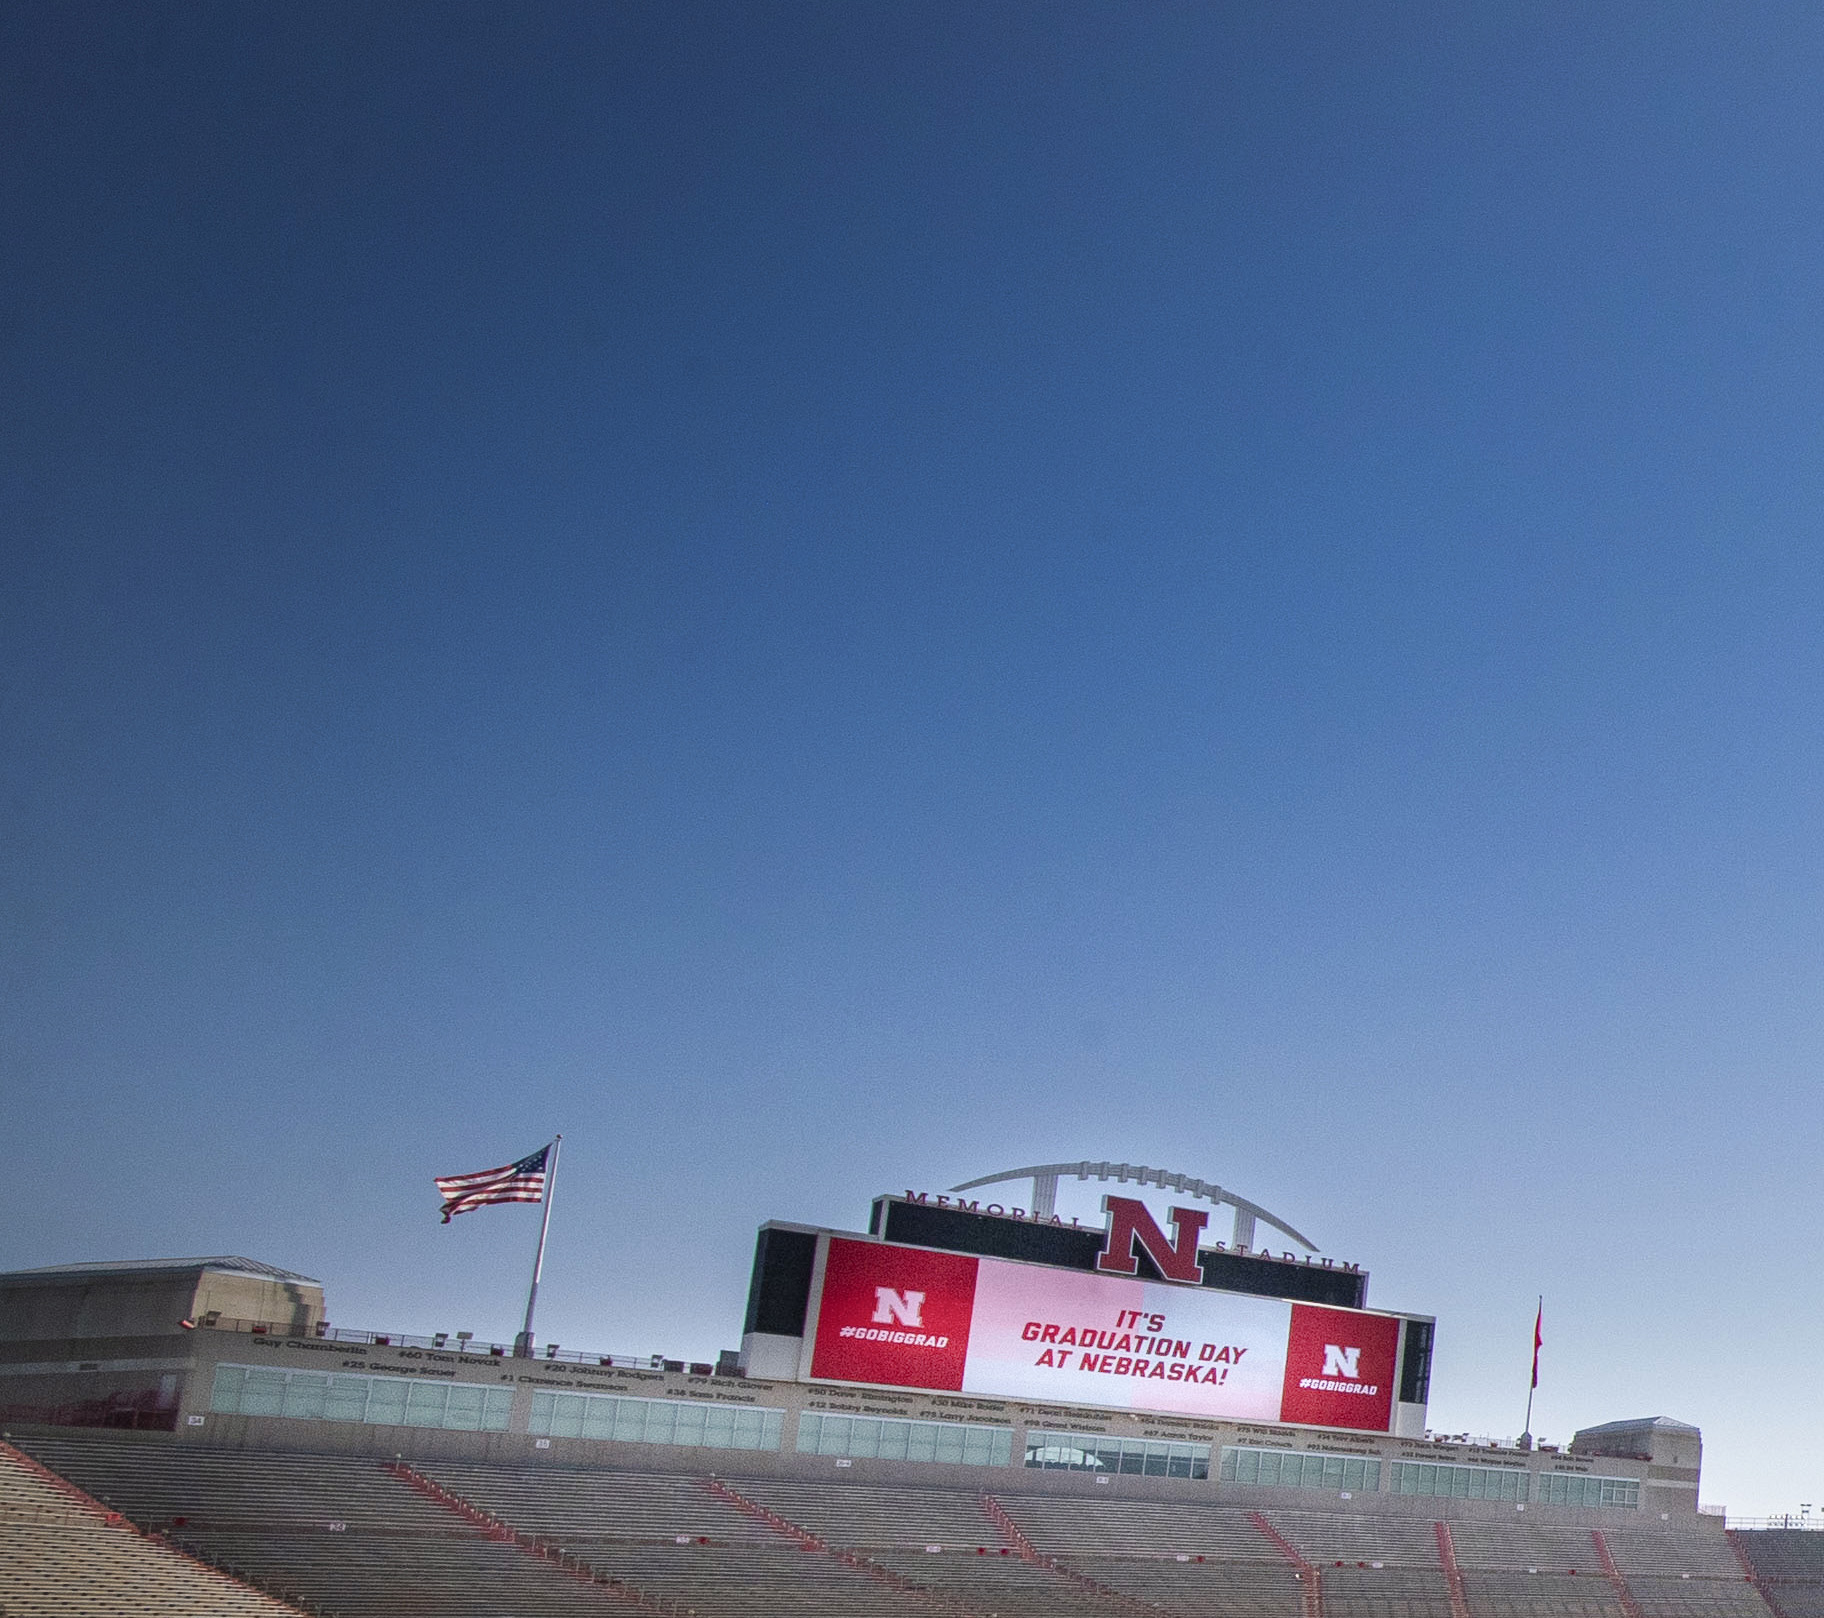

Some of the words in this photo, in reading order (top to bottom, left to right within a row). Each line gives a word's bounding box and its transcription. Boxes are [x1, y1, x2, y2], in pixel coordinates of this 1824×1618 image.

[905, 1190, 1080, 1229] MEMORIAL
[1096, 1193, 1210, 1284] N
[1216, 1241, 1361, 1272] STADIUM
[872, 1287, 925, 1327] N
[1116, 1309, 1165, 1333] IT'S
[253, 1338, 282, 1348] Guy
[838, 1326, 949, 1350] #GOBIGGRAD
[1022, 1321, 1193, 1363] GRADUATION
[1199, 1343, 1248, 1366] DAY
[1036, 1348, 1074, 1368] AT
[1081, 1352, 1229, 1386] NEBRASKA!
[1323, 1344, 1361, 1379] N
[1300, 1377, 1378, 1396] #GOBIGGRAD
